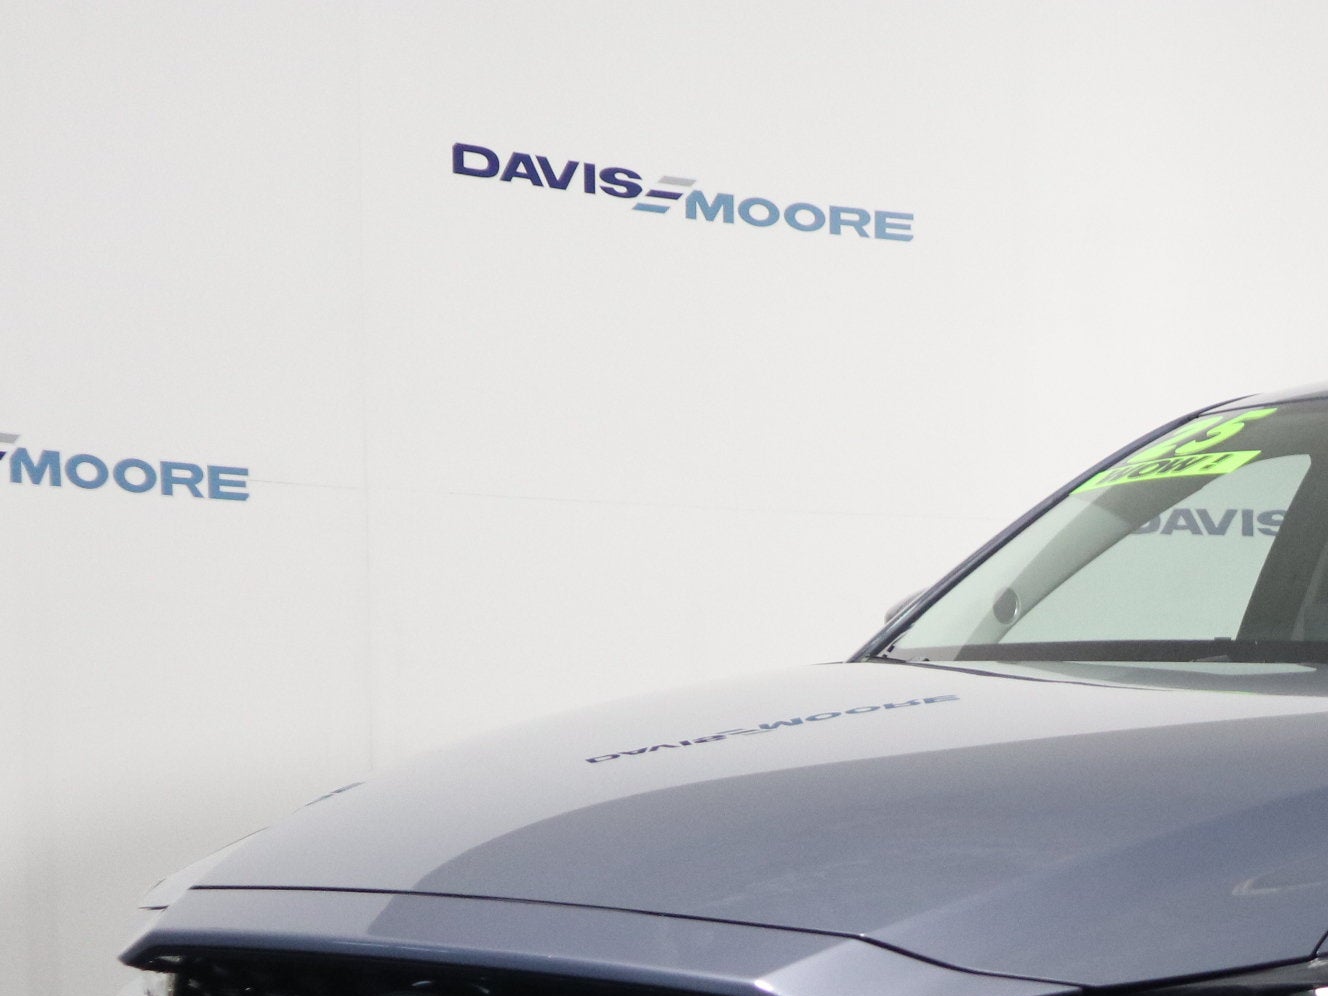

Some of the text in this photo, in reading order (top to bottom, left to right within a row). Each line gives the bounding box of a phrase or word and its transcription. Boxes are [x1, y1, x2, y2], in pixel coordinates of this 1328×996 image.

[452, 142, 915, 242] DAVIS MOORE
[9, 447, 250, 501] MOORE
